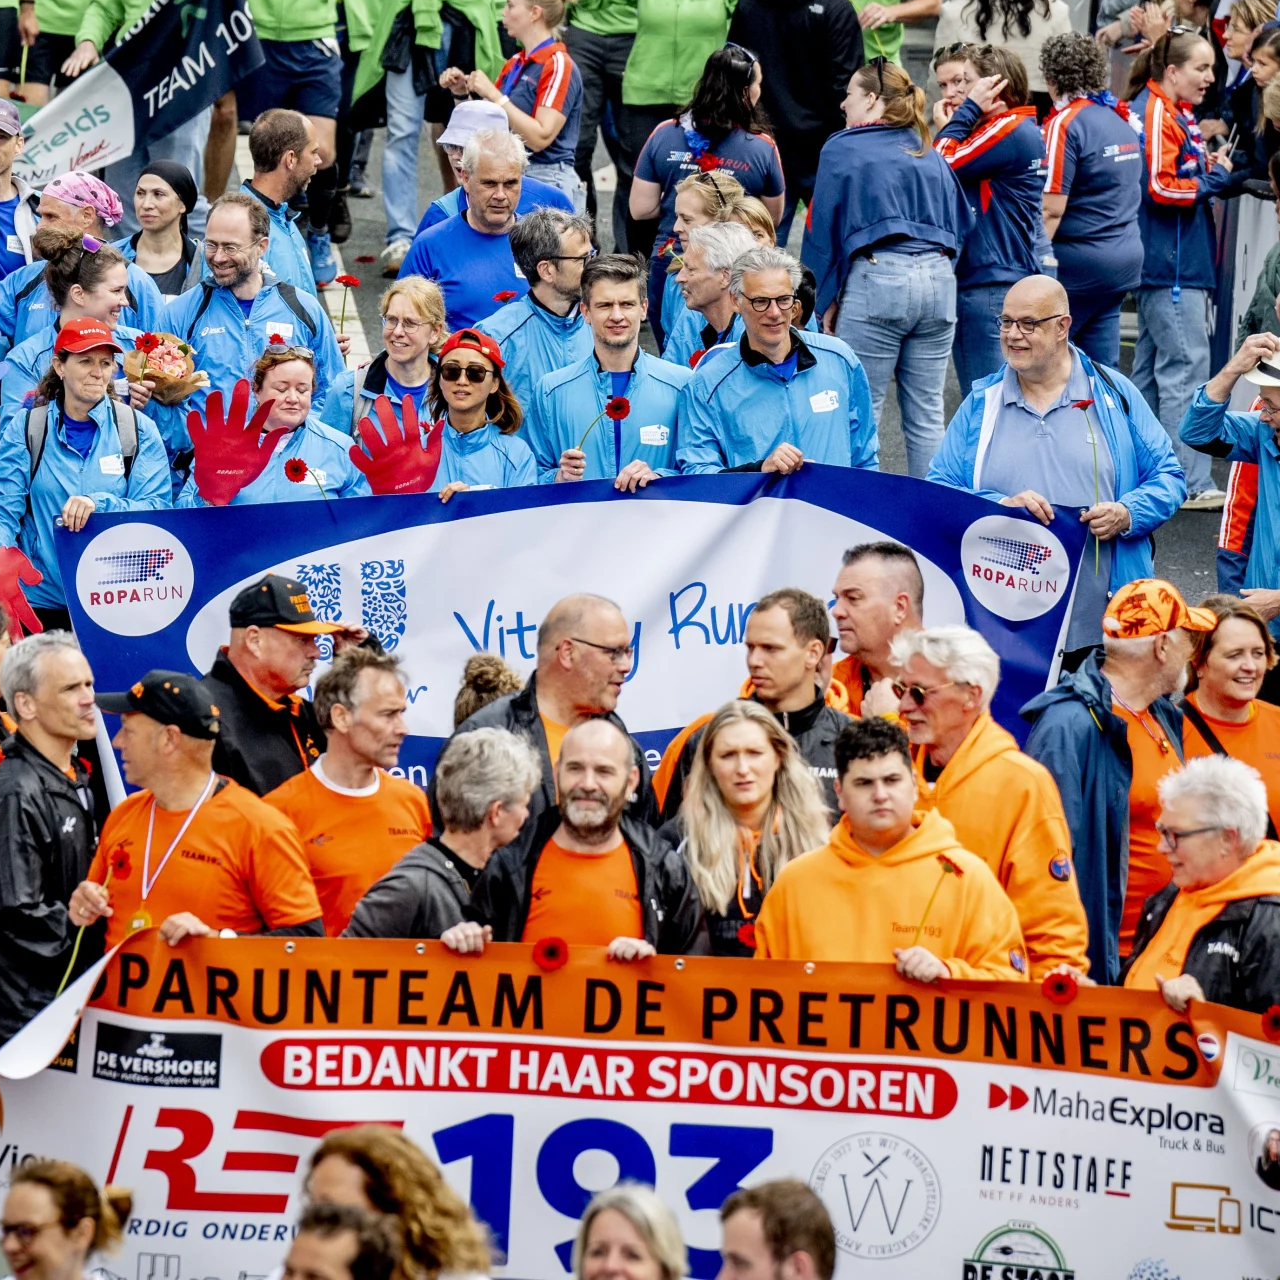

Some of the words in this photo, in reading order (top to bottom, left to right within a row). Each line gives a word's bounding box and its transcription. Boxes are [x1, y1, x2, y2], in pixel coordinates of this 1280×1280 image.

[143, 41, 217, 118] TEAM
[79, 327, 107, 336] ROPARUN
[659, 431, 669, 442] 51
[971, 563, 1057, 593] ROPARUN
[89, 584, 184, 607] ROPARUN
[891, 921, 918, 934] Team
[923, 925, 943, 938] 193
[583, 978, 666, 1036] DE
[702, 986, 1199, 1080] PRETRUNNERS
[97, 1050, 117, 1069] DE
[120, 1053, 217, 1077] VERSHOEK
[282, 1044, 498, 1088] BEDANKT
[508, 1049, 635, 1097] HAAR
[645, 1055, 936, 1115] SPONSOREN
[1033, 1086, 1226, 1135] MahaExplora
[1158, 1135, 1188, 1151] Truck
[1193, 1139, 1202, 1151] &
[1206, 1140, 1226, 1154] Bus
[980, 1144, 1132, 1194] NETTSTAFF
[432, 1113, 774, 1280] 193
[979, 1189, 1004, 1201] NET
[1029, 1194, 1080, 1209] ANDERS
